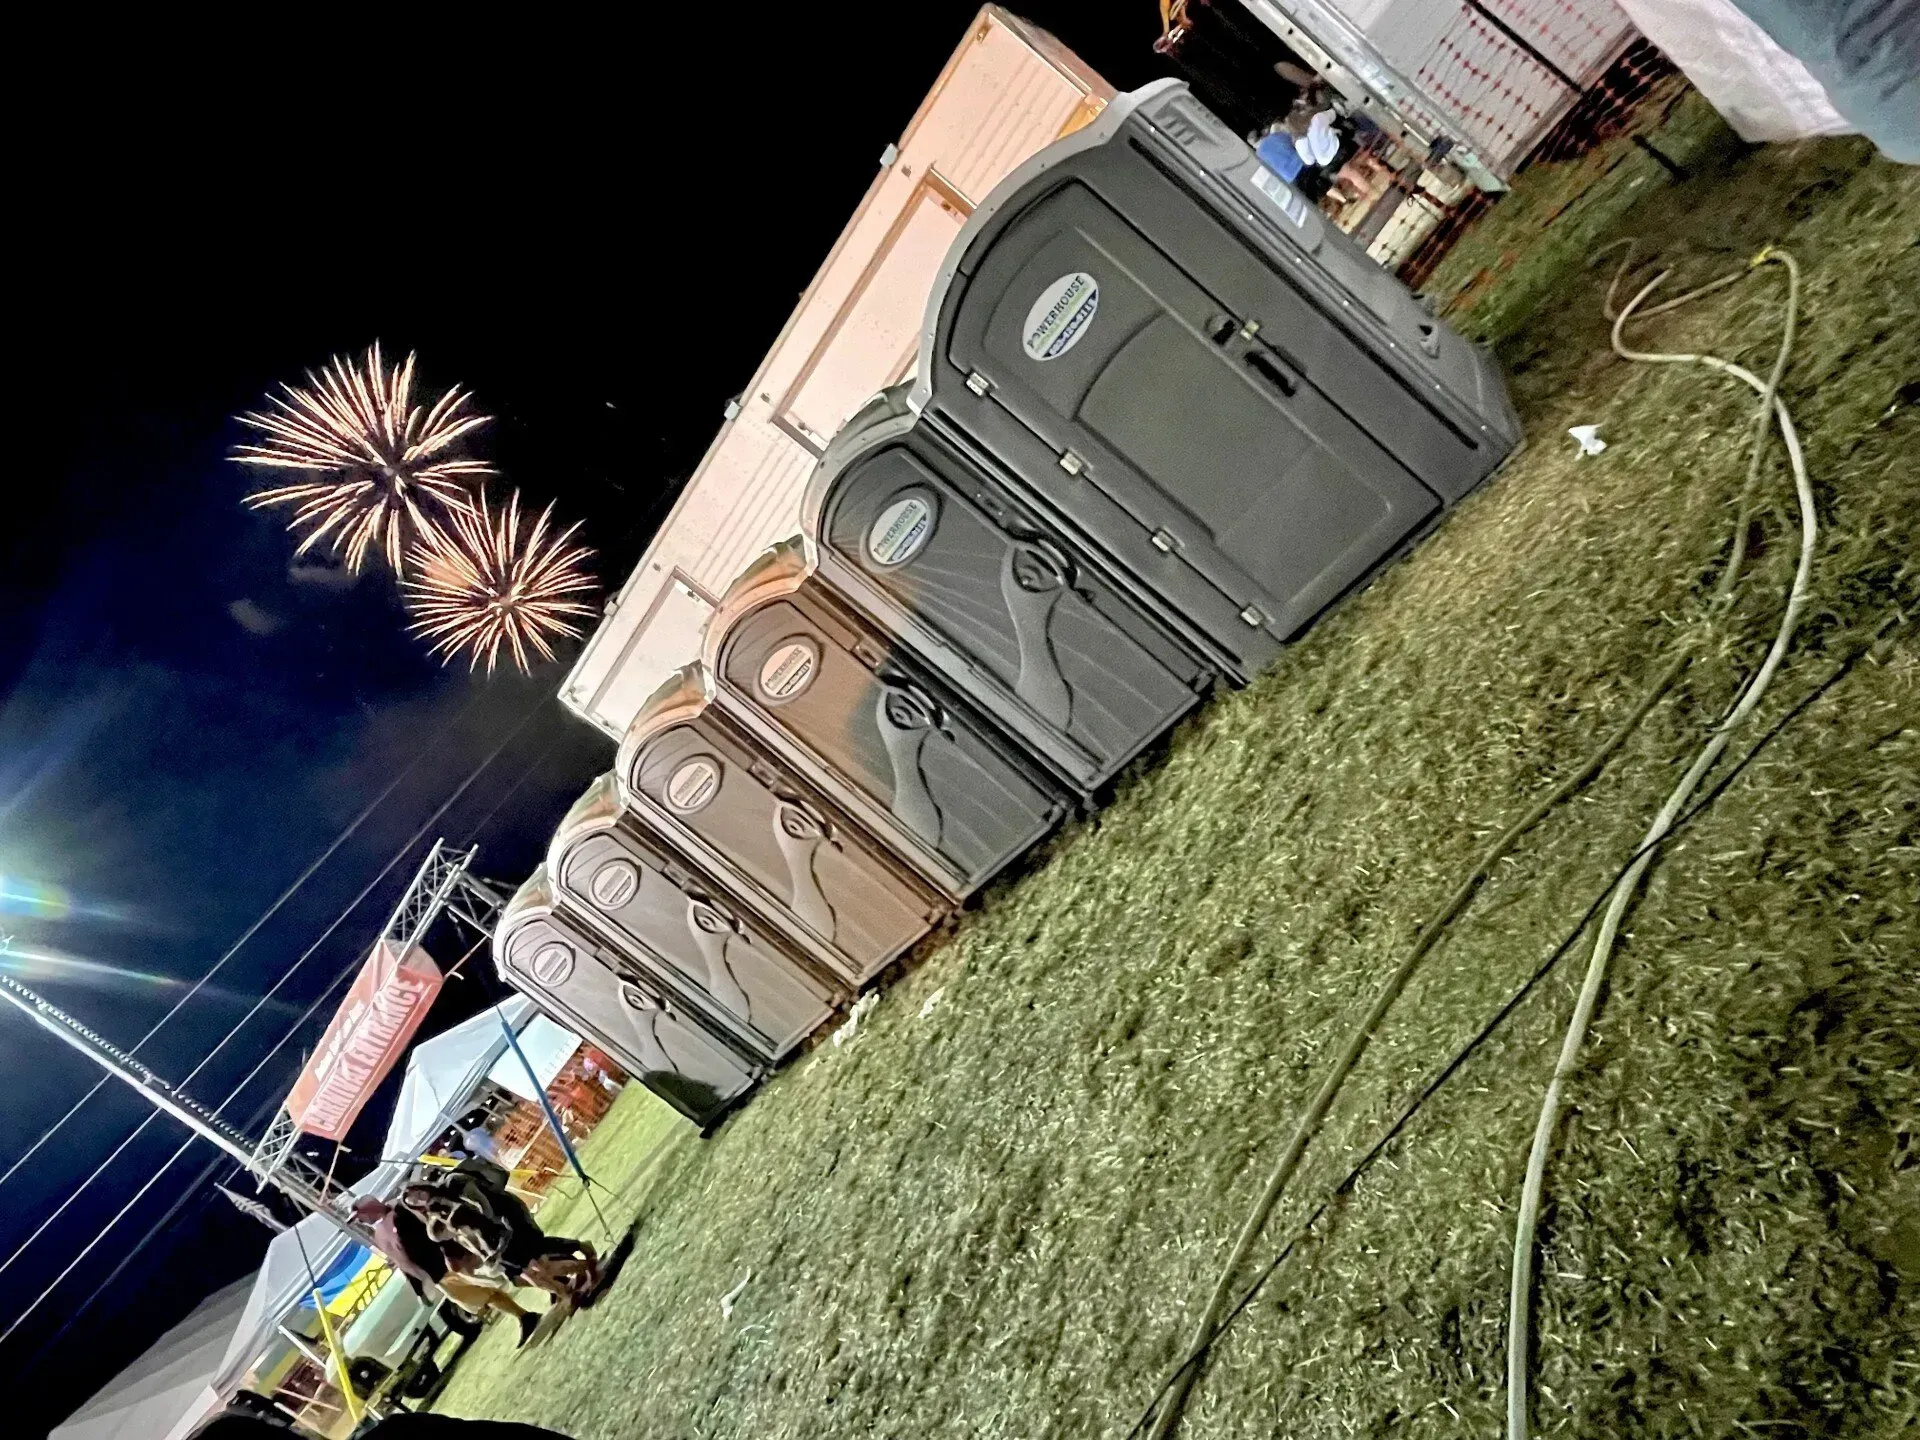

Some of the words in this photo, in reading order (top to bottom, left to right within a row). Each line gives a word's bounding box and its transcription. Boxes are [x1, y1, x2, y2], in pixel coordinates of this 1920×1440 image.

[1026, 275, 1085, 350] POWERHOUSE
[304, 1056, 371, 1131] CARNIVAL
[349, 978, 424, 1065] ENTRANCE
